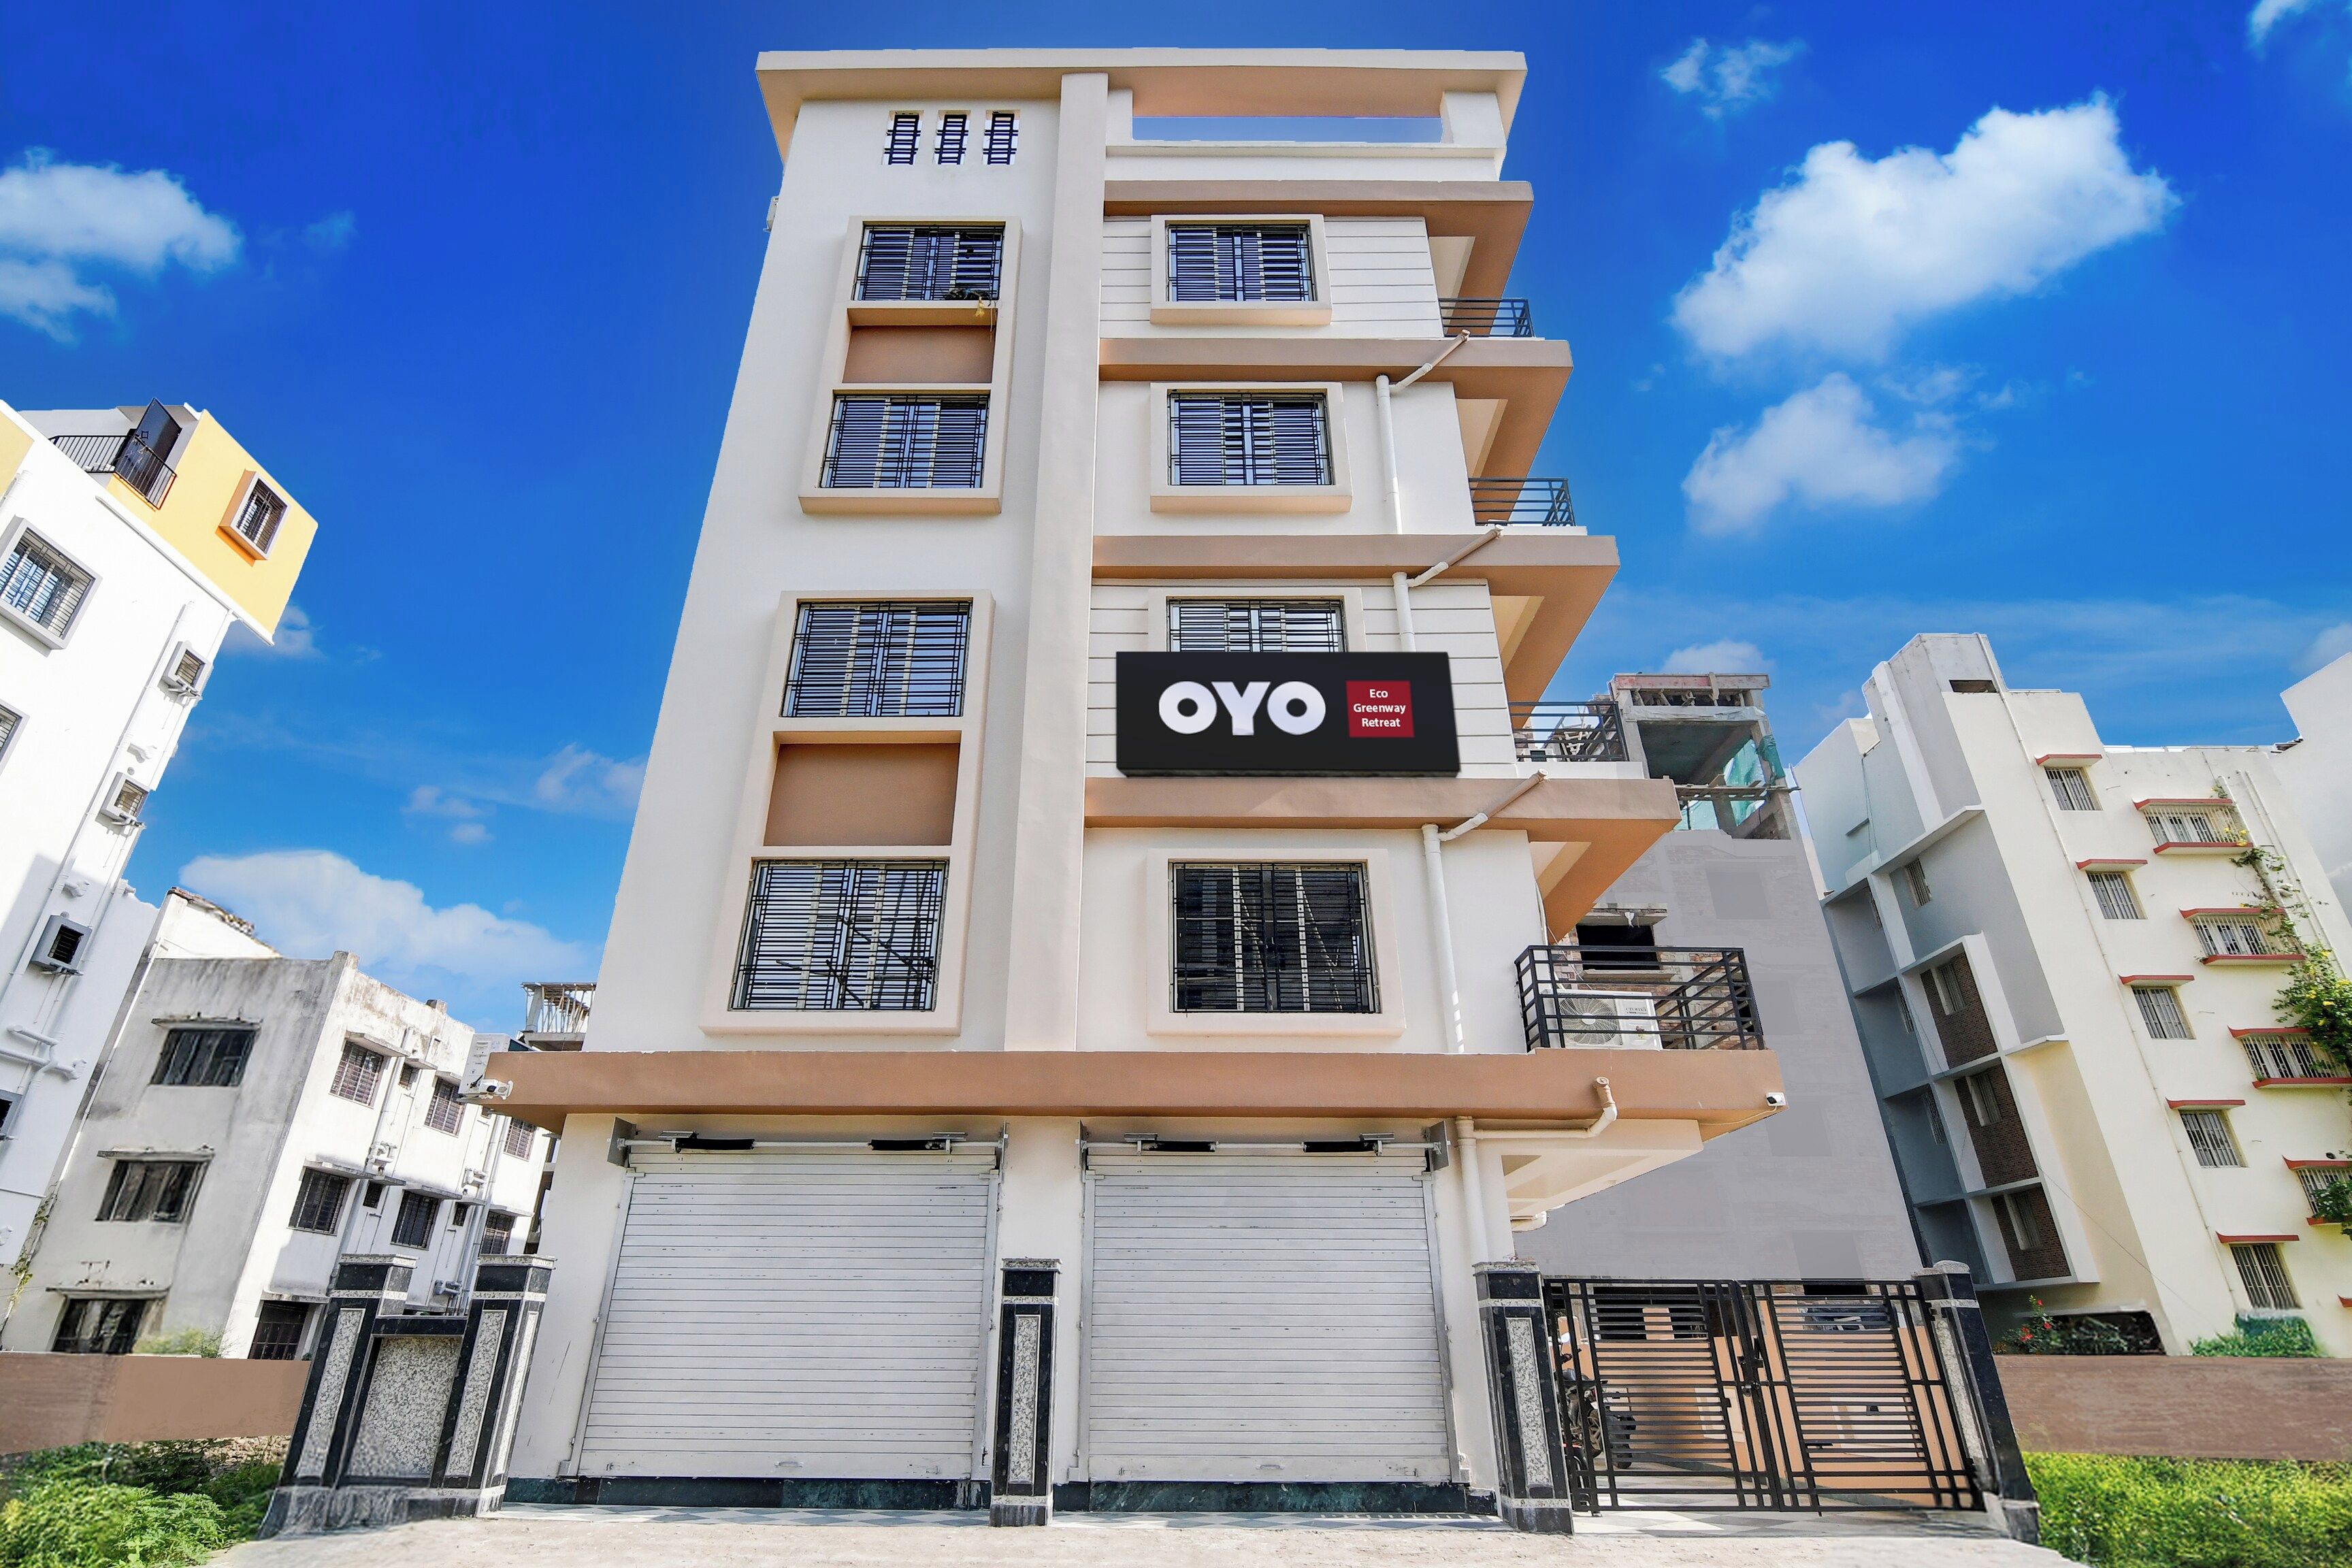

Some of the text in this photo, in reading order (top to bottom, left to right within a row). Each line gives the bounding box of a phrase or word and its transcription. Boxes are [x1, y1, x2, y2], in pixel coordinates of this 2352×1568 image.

[1369, 689, 1388, 698] Eco
[1158, 681, 1326, 736] OYO
[1353, 703, 1406, 715] Greenway
[1361, 717, 1401, 728] Retreat
